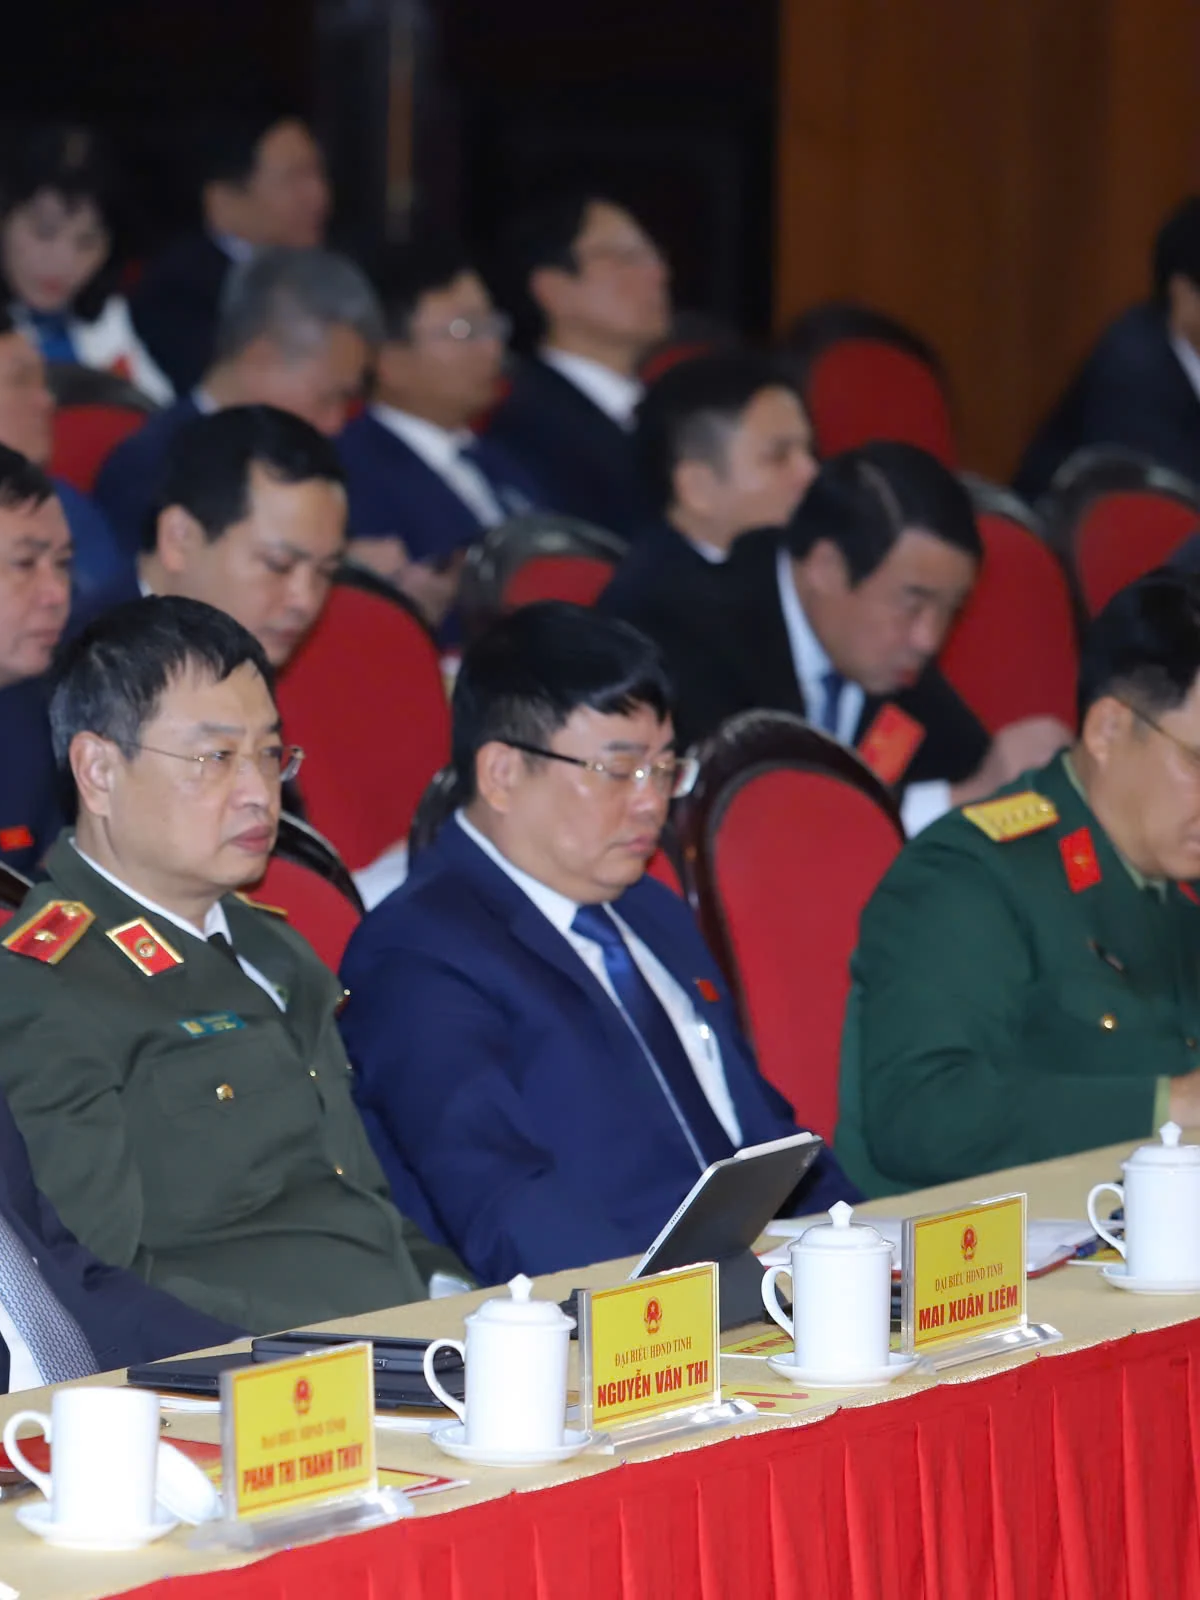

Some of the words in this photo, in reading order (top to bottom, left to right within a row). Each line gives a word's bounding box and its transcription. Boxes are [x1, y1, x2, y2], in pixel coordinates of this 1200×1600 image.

[918, 1304, 944, 1331] MAI
[949, 1293, 984, 1323] XUÂN
[988, 1284, 1018, 1313] LIÊM
[597, 1369, 651, 1408] NGUYỄN
[655, 1364, 682, 1394] VĂN
[686, 1360, 708, 1386] THI
[299, 1450, 334, 1481] THANH
